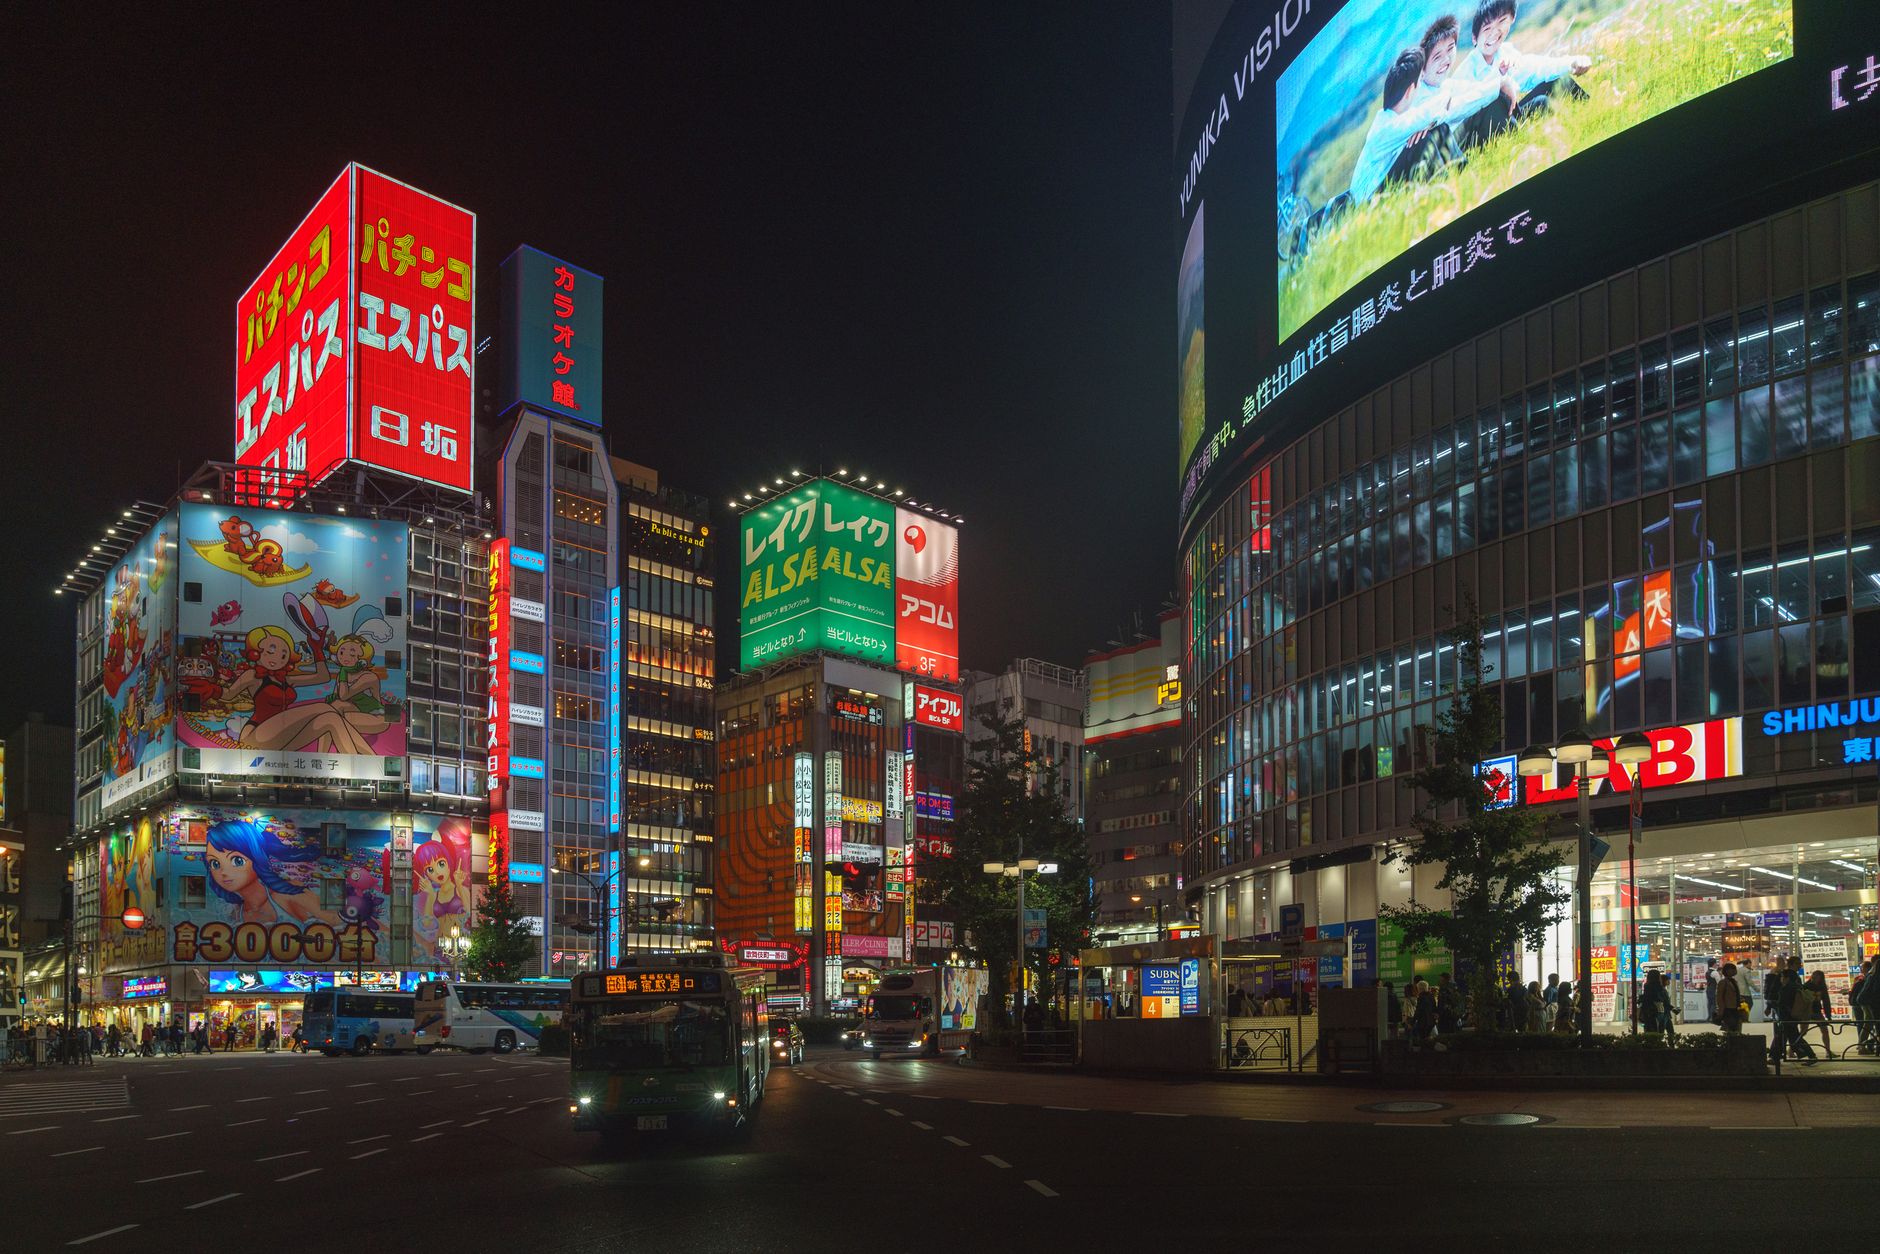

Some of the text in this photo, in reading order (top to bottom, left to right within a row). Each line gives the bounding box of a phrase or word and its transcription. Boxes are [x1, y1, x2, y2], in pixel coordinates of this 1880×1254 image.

[1180, 93, 1230, 219] YUNIKA
[360, 217, 470, 302] パチンコ
[245, 224, 332, 364] パチンコ
[357, 291, 470, 378] エスパス
[552, 266, 577, 409] カラオケ館
[236, 298, 343, 460] エスパス
[651, 523, 705, 548] Public stand
[745, 498, 817, 566] レイク
[824, 502, 890, 548] レイク
[743, 546, 818, 609] ALSA
[821, 546, 891, 590] ALSA
[901, 594, 954, 630] アコム
[752, 634, 795, 658] 当ビルとなり
[827, 626, 878, 649] 当ビルとなり
[920, 656, 937, 671] 3F
[917, 693, 961, 717] アイフル
[293, 759, 340, 771] 北電子
[803, 765, 811, 817] 小松ビル
[1379, 923, 1392, 937] 5F
[552, 952, 588, 963] ダーツ
[745, 950, 787, 960] 歌舞伎町一番街
[627, 978, 694, 991] 新宿駅西口
[1147, 1001, 1157, 1015] 4
